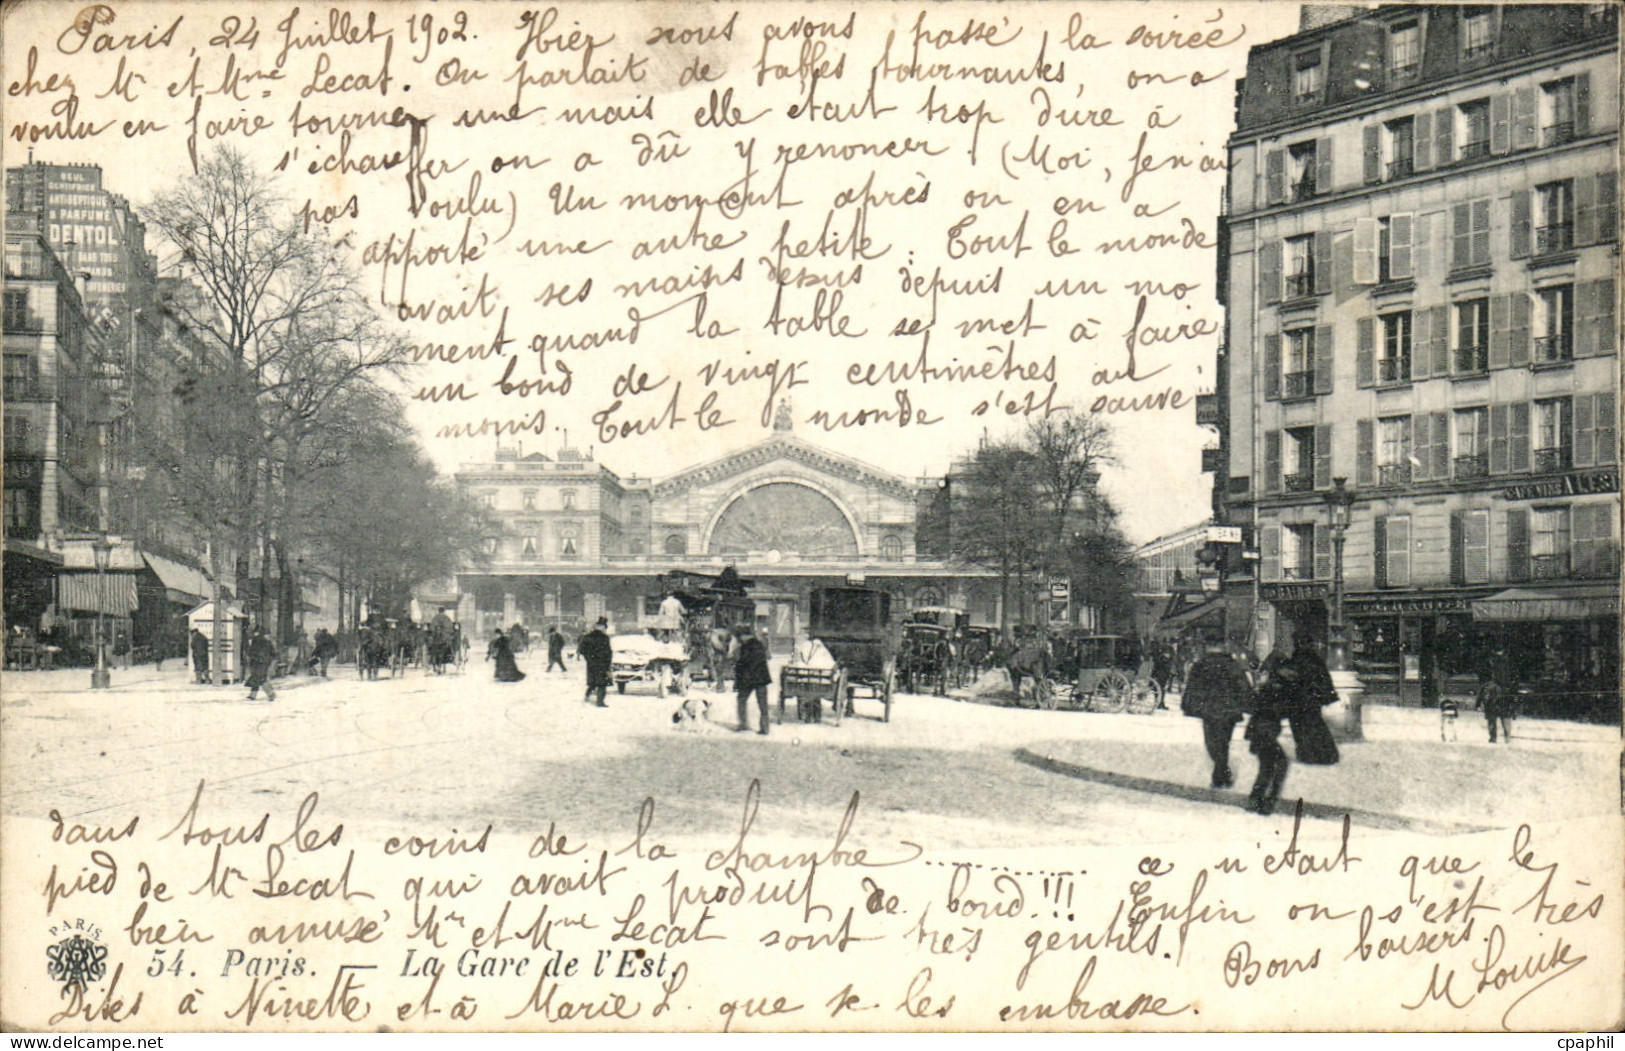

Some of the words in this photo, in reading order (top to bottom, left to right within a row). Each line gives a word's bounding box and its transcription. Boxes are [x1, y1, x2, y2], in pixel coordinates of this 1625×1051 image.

[8, 46, 78, 117] chez
[167, 57, 204, 97] et
[436, 57, 488, 85] On
[504, 53, 649, 104] parlait
[680, 56, 726, 84] de
[755, 41, 853, 87] tables
[1128, 68, 1186, 89] on
[1190, 68, 1230, 86] a
[209, 16, 260, 48] 24
[274, 7, 394, 68] Juillet
[515, 7, 613, 62] Hier
[645, 11, 738, 46] nous
[762, 12, 855, 42] avons
[912, 11, 1022, 78] passé
[1060, 13, 1111, 50] la
[1125, 8, 1246, 47] soirée
[11, 95, 116, 142] voulu
[123, 120, 166, 139] en
[186, 95, 273, 175] faire
[289, 100, 435, 137] tourner
[453, 103, 547, 127] une
[556, 95, 653, 124] mais
[695, 87, 772, 127] elle
[917, 85, 1004, 165] trop
[491, 155, 551, 173] on
[574, 152, 602, 171] a
[632, 130, 690, 166] dû
[49, 223, 119, 245] DENTOL
[293, 195, 357, 233] pas
[549, 182, 606, 215] Un
[620, 165, 802, 212] moment
[834, 171, 930, 243] après
[964, 188, 1011, 207] on
[1053, 196, 1104, 214] en
[1134, 201, 1179, 217] a
[363, 216, 487, 305] apporté
[517, 238, 612, 255] une
[631, 205, 746, 259] autre
[947, 210, 1031, 260] Tout
[1046, 217, 1079, 258] le
[1095, 217, 1216, 254] monde
[527, 290, 706, 375] quand
[687, 291, 739, 338] la
[764, 281, 867, 338] table
[888, 316, 932, 337] se
[960, 298, 1046, 338] met
[1069, 318, 1100, 342] à
[1122, 296, 1217, 378] faire
[533, 277, 592, 306] ses
[898, 266, 1002, 323] depuis
[1034, 279, 1106, 297] un
[413, 383, 477, 402] un
[493, 355, 572, 396] bond
[612, 364, 670, 398] de
[699, 350, 808, 428] vingt
[1092, 363, 1172, 386] au
[592, 381, 685, 443] Tout
[694, 390, 736, 431] le
[806, 389, 944, 428] monde
[971, 382, 1070, 418] s'est
[49, 809, 139, 845] dans
[158, 778, 270, 846] tous
[274, 790, 344, 852] les
[385, 824, 493, 856] coins
[529, 822, 587, 856] de
[616, 796, 677, 860] la
[705, 777, 922, 870] chambre
[1138, 855, 1175, 875] ce
[1400, 855, 1480, 904] que
[1510, 824, 1550, 870] le
[43, 850, 117, 915] pied
[139, 862, 174, 901] de
[405, 872, 481, 926] qui
[510, 850, 626, 897] avait
[663, 857, 832, 925] produit
[1129, 869, 1255, 967] Enfin
[1289, 903, 1357, 922] on
[1378, 875, 1501, 923] s'est
[1512, 863, 1604, 925] très
[124, 901, 214, 945] bien
[249, 908, 390, 944] amusé
[472, 900, 513, 949] et
[761, 907, 886, 952] sont
[904, 898, 984, 954] très
[49, 962, 143, 1024] Dites
[178, 988, 204, 1016] à
[225, 966, 371, 1026] Ninette
[397, 963, 442, 1022] et
[450, 996, 478, 1021] à
[720, 996, 804, 1033] que
[895, 966, 955, 1018] les
[1223, 940, 1321, 988] Bons
